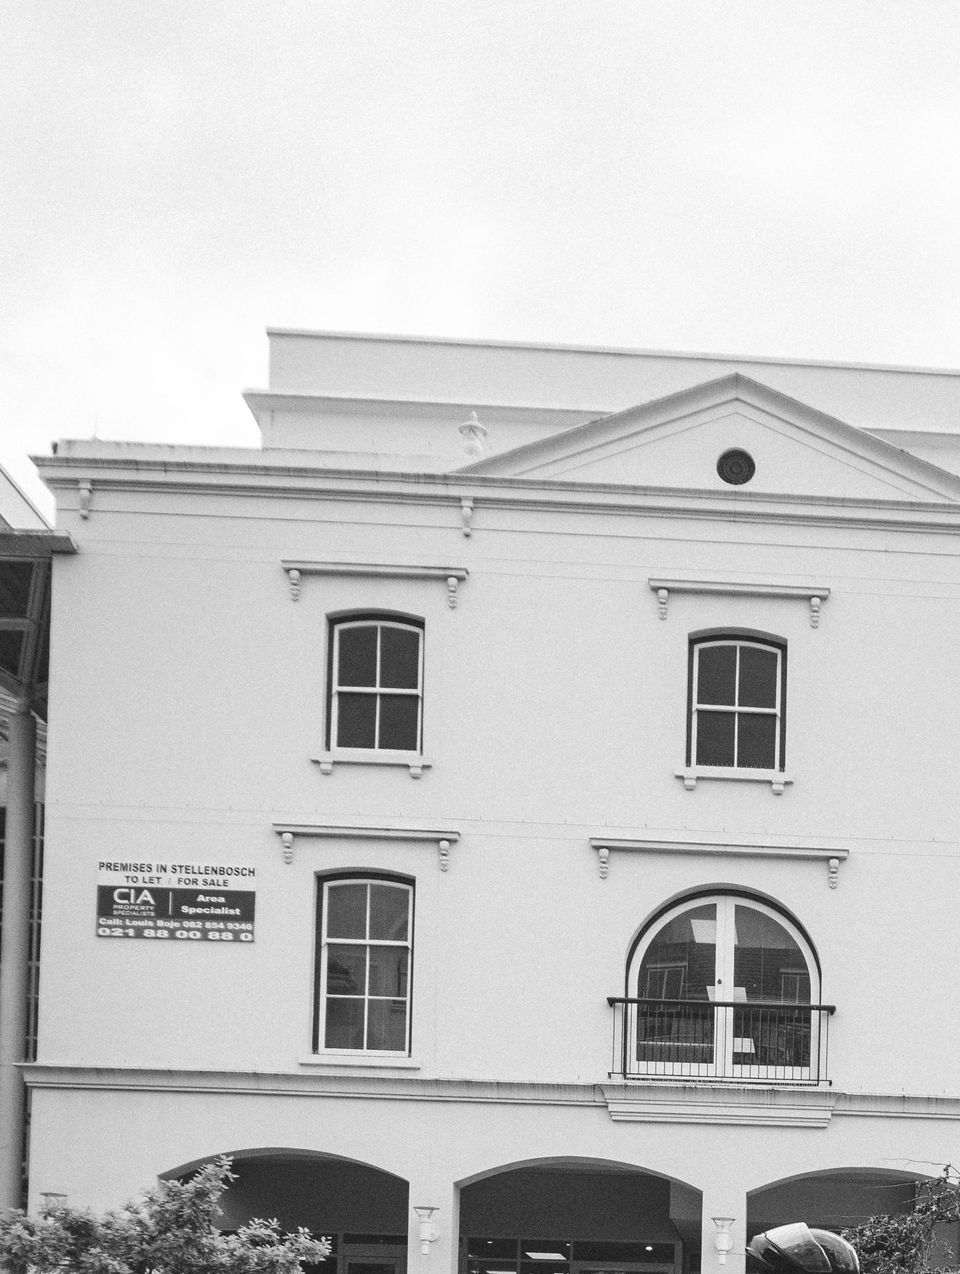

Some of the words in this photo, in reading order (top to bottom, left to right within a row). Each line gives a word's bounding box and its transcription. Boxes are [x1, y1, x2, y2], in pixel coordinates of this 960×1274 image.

[98, 862, 153, 873] PREMISES
[156, 864, 167, 874] IN
[170, 864, 256, 877] STELLENBOSCH
[124, 875, 138, 884] TO
[142, 876, 163, 884] LET
[177, 877, 199, 886] FOR
[202, 878, 229, 887] SALE
[113, 888, 156, 905] CIA
[197, 894, 226, 903] Area
[180, 905, 241, 916] Specialist
[99, 917, 123, 925] Call:
[125, 919, 154, 927] Louis
[97, 927, 135, 937] 021
[143, 929, 170, 938] 88
[175, 930, 202, 939] 00
[207, 931, 233, 941] 88
[240, 932, 253, 941] 0
